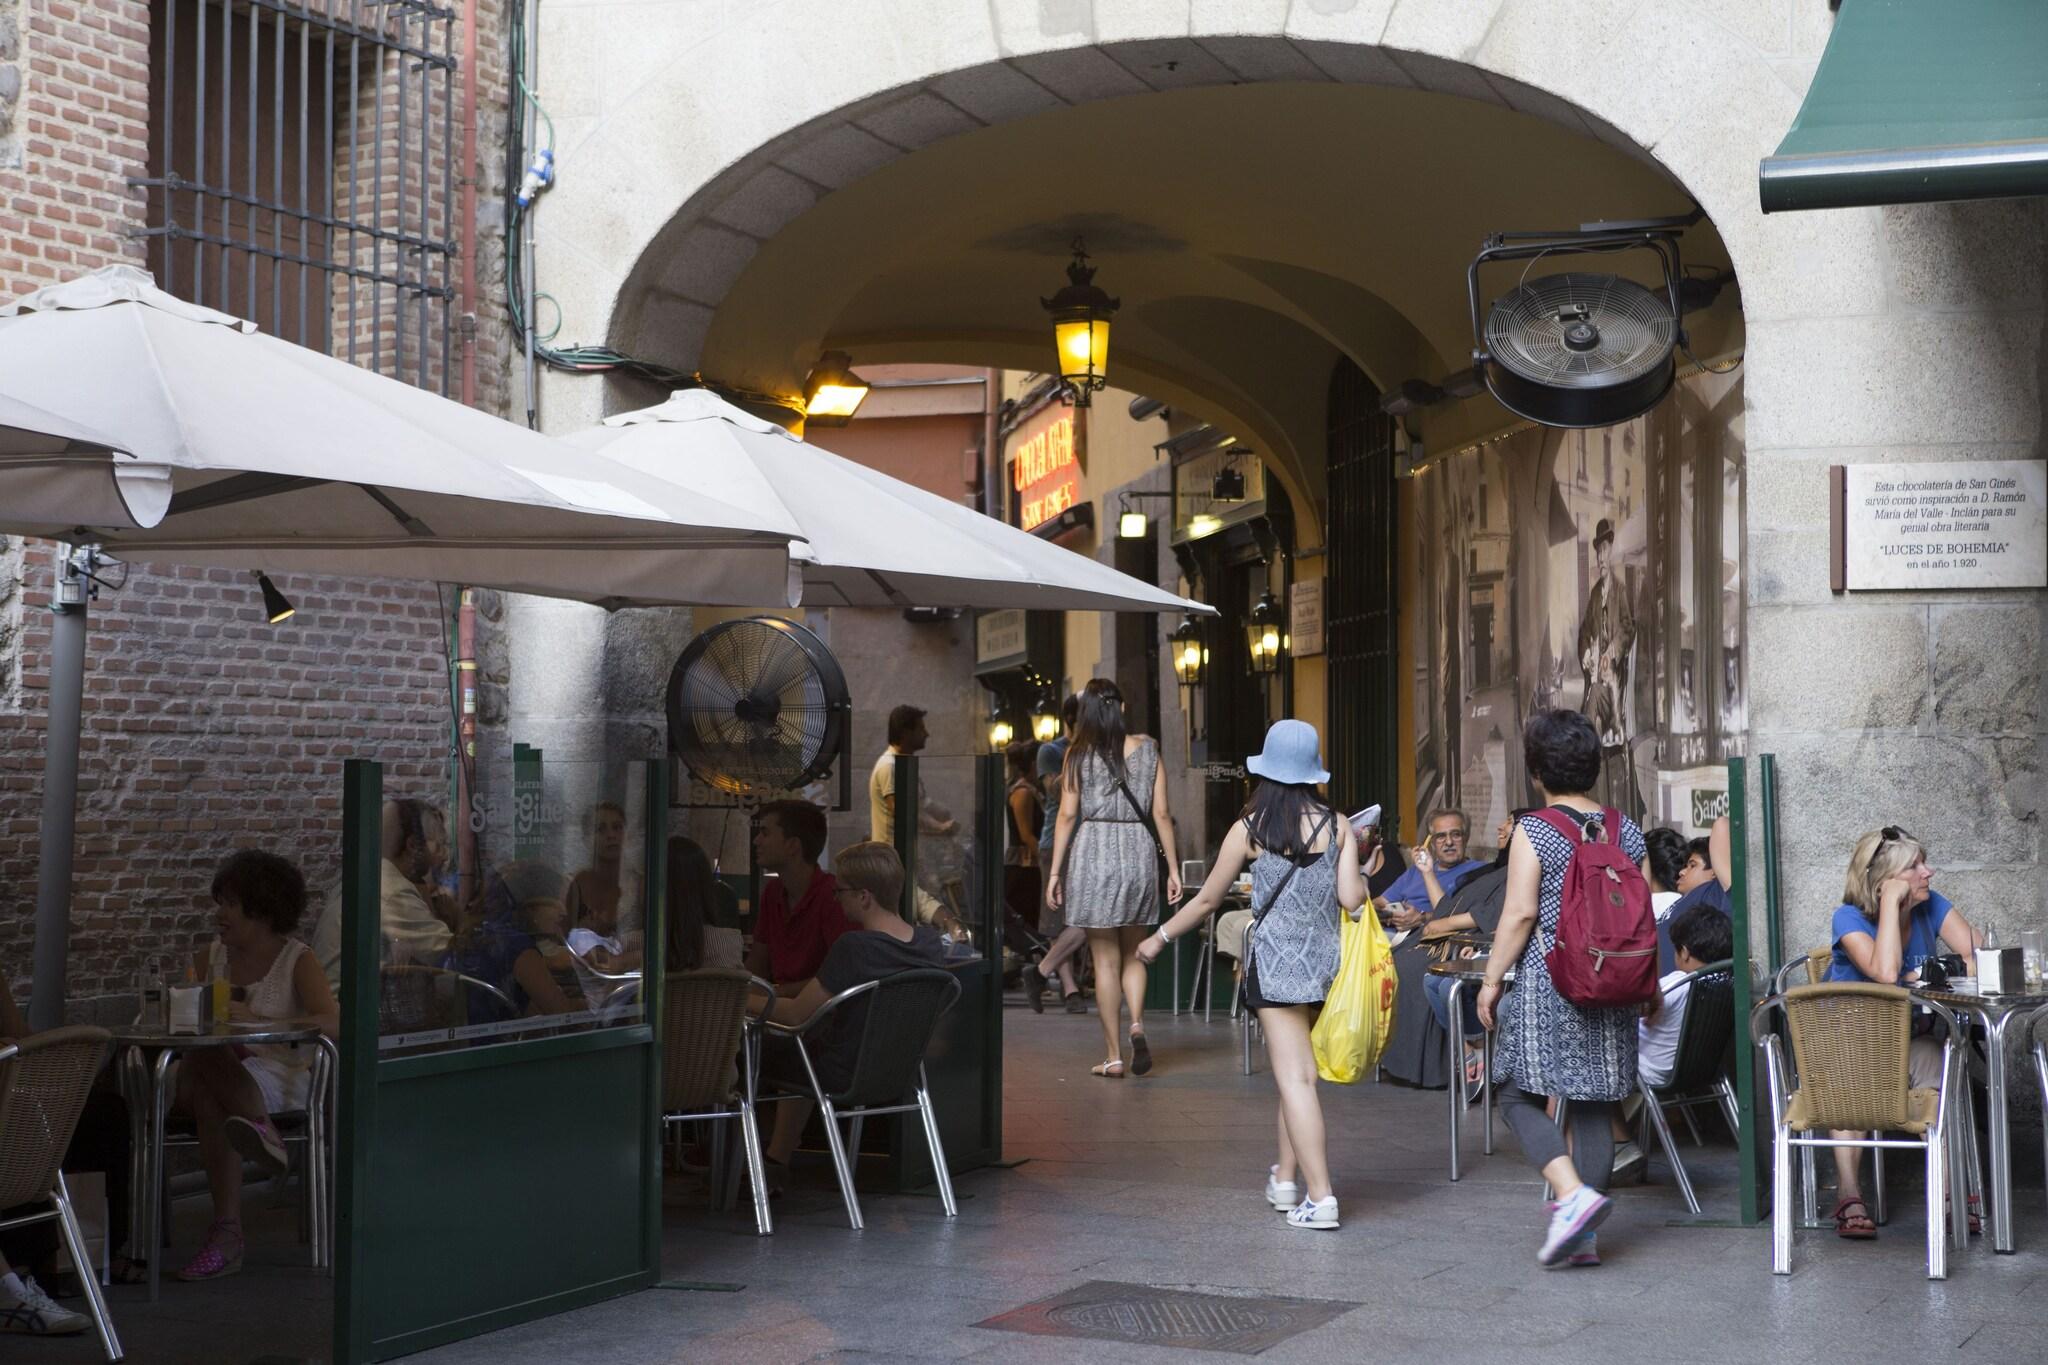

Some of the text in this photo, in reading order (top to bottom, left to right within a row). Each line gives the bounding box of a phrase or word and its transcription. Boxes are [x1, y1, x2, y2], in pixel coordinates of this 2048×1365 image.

[1875, 477, 2016, 492] Esta chocolatería de San Ginés
[1892, 496, 1917, 506] como
[1919, 492, 1970, 507] inspiración
[1972, 495, 1978, 503] a
[1980, 492, 1990, 503] D.
[1993, 490, 2026, 503] Ramón
[1875, 508, 1901, 520] María
[1903, 508, 1918, 519] del
[1920, 507, 1943, 519] Valle
[1950, 506, 1980, 518] Inclán
[1981, 507, 2003, 519] para
[2004, 507, 2016, 517] su
[1901, 520, 1990, 535] genial obra literaria
[1927, 543, 1944, 555] DE
[1907, 560, 1919, 569] en
[1921, 559, 1930, 569] el
[1932, 559, 1950, 569] año
